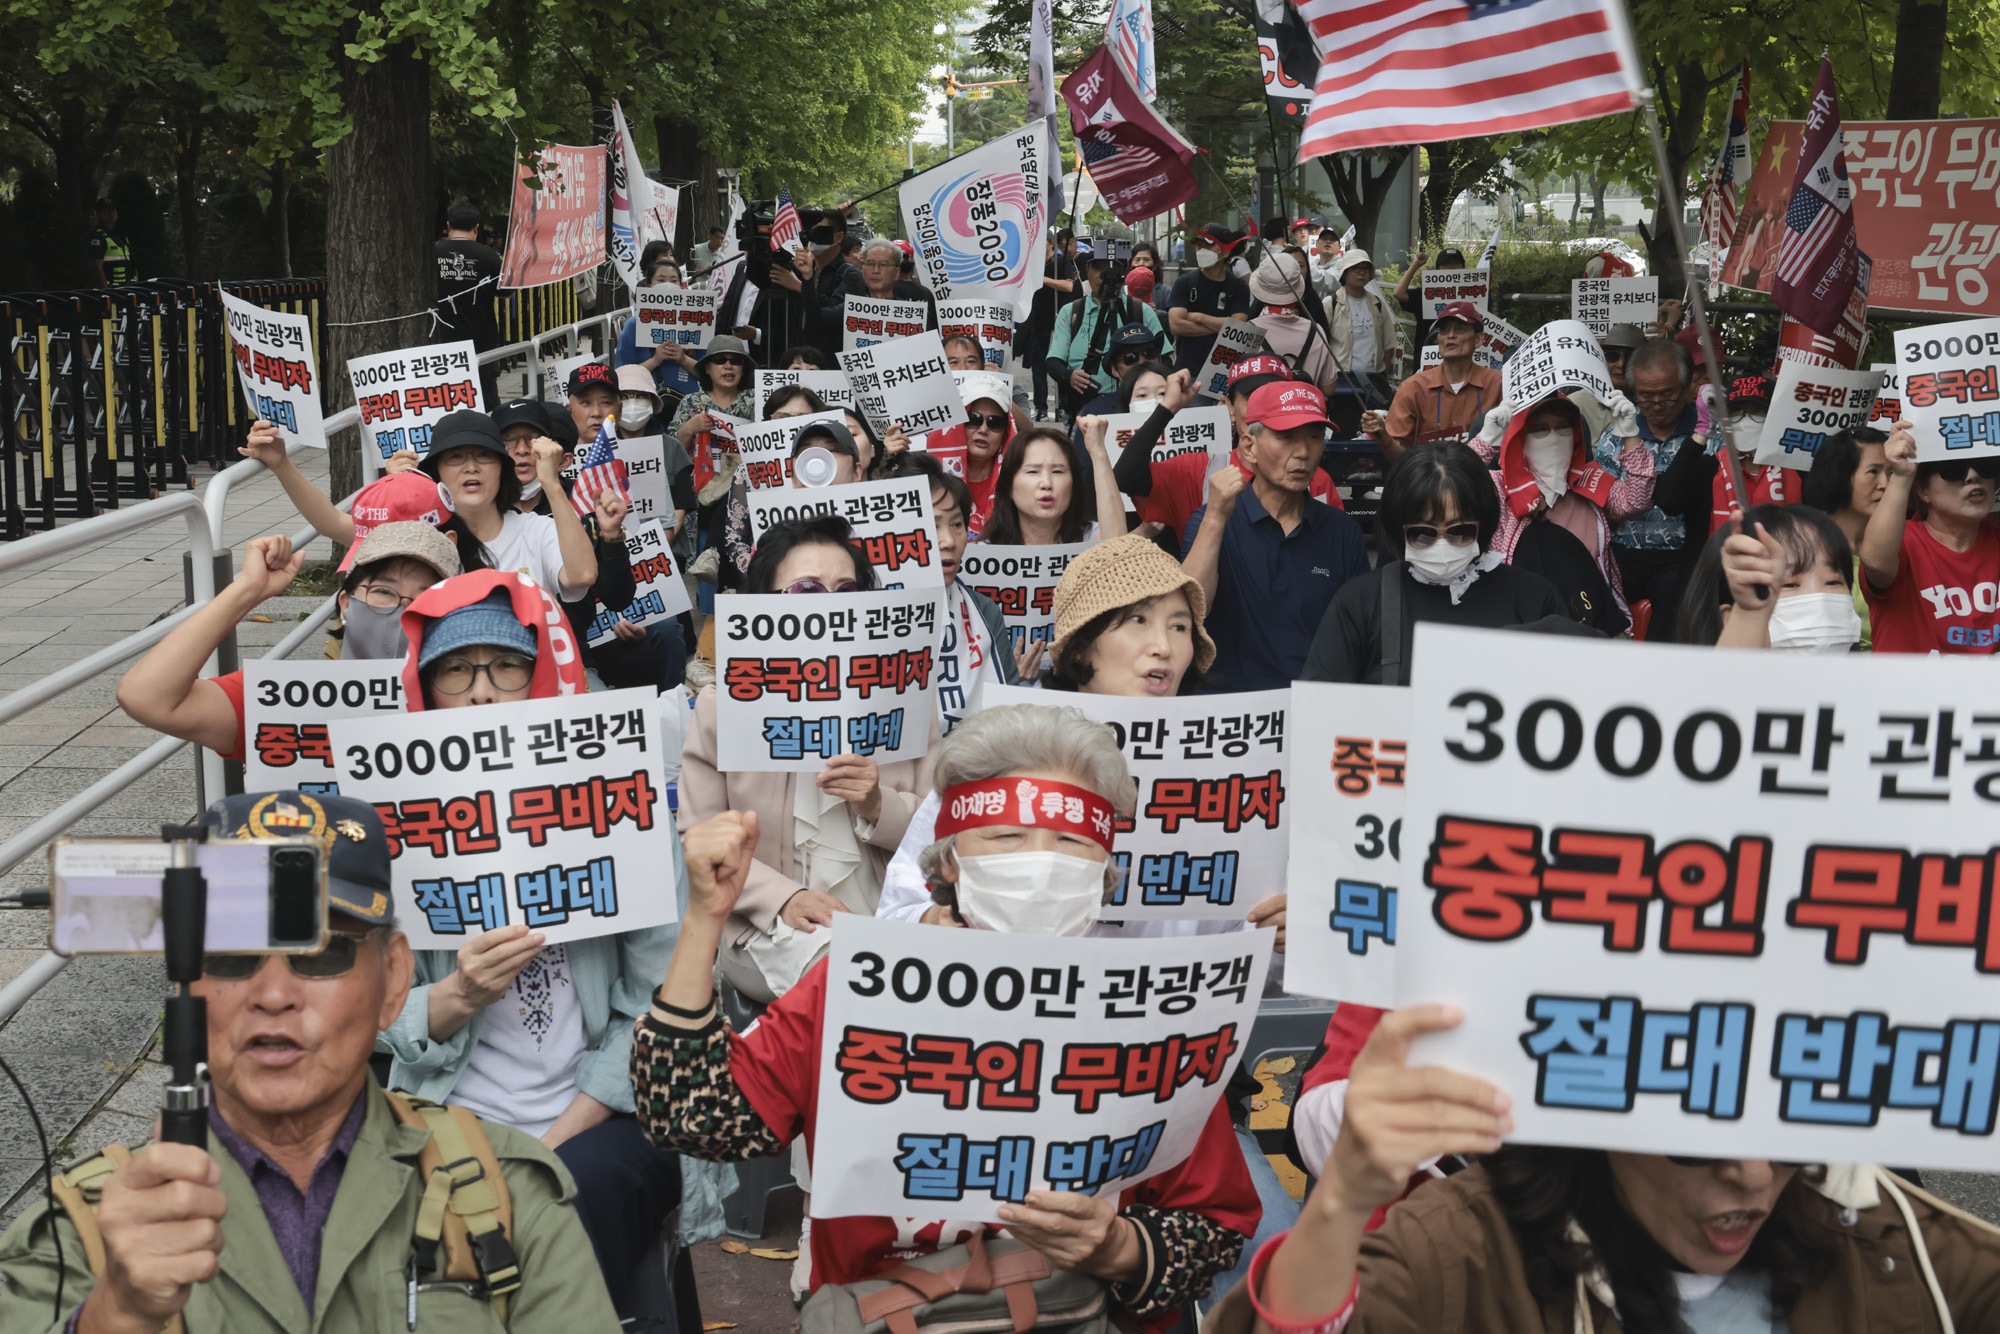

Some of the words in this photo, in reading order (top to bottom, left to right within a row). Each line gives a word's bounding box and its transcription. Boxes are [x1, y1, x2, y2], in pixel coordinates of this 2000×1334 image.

[1843, 127, 1937, 207] 중국인
[913, 202, 938, 244] 당신이
[966, 178, 1009, 283] 장풍2030
[1424, 286, 1456, 300] 중국인
[1458, 284, 1487, 298] 무비자
[1425, 274, 1461, 283] 3000만
[1463, 272, 1487, 282] 관광객
[1578, 280, 1610, 292] 중국인
[640, 294, 682, 306] 3000만
[685, 295, 714, 307] 관광객
[847, 301, 890, 317] 3000만
[893, 305, 924, 319] 관광객
[939, 305, 986, 319] 3000만
[1578, 293, 1610, 306] 관광객
[1613, 291, 1656, 305] 유치보다
[1578, 308, 1610, 320] 자국민
[639, 308, 677, 324] 중국인
[678, 310, 714, 326] 무비자
[846, 316, 883, 335] 중국인
[885, 322, 924, 337] 무비자
[255, 318, 304, 351] 관광객
[651, 328, 676, 344] 절대
[677, 330, 701, 345] 반대
[1504, 329, 1526, 345] 관광
[253, 349, 312, 395] 무비자
[352, 360, 406, 388] 3000만
[411, 350, 470, 379] 관광객
[578, 365, 610, 373] STOP
[842, 349, 876, 373] 중국인
[1210, 344, 1245, 370] 중국
[1231, 358, 1261, 378] 이재명
[1777, 345, 1827, 368] SECURITY
[578, 374, 613, 384] STEAL
[762, 372, 799, 386] 중국인
[850, 371, 882, 394] 관광객
[882, 355, 947, 389] 유치보다
[1509, 355, 1554, 393] 자국민
[1562, 368, 1614, 400] 먼저다!
[1731, 376, 1767, 387] STOP
[1906, 365, 1999, 408] 중국인
[358, 389, 402, 425] 중국인
[404, 379, 477, 416] 무비자
[859, 395, 888, 415] 자국민
[1280, 390, 1294, 405] STOP
[1295, 389, 1306, 398] THE
[1729, 388, 1768, 400] STEAL
[1794, 381, 1847, 408] 중국인
[257, 394, 298, 434] 반대
[894, 405, 953, 434] 먼저다!
[375, 427, 408, 460] 절대
[740, 429, 786, 454] 3000만
[1169, 422, 1215, 444] 관광객
[1779, 427, 1829, 457] 무비
[1939, 411, 2000, 450] 절대
[746, 458, 784, 489] 중국인
[366, 507, 389, 520] THE
[844, 490, 923, 526] 관광객
[849, 528, 932, 572] 비자
[1311, 566, 1330, 577] Jeep
[967, 586, 1028, 616] 국인
[1920, 582, 2000, 619] YOO
[727, 608, 857, 642] 3000만
[864, 601, 936, 640] 관광객
[724, 655, 841, 702] 중국인
[846, 646, 933, 699] 무비자
[257, 676, 403, 710] 3000만
[346, 725, 515, 781] 3000만
[527, 708, 648, 766] 관광객
[762, 716, 841, 760] 절대
[848, 707, 904, 757] 반대
[1179, 710, 1285, 759] 관광객
[1442, 688, 1845, 799] 3000만
[375, 789, 501, 860] 중국인
[507, 768, 659, 847] 무비자
[950, 788, 1007, 821] 이재명
[1040, 791, 1084, 824] 투쟁
[1091, 806, 1113, 840] 구속
[1145, 769, 1286, 834] 무비자
[1138, 850, 1240, 906] 반대
[1424, 812, 1773, 958] 중국인
[411, 871, 510, 936] 절대
[515, 855, 619, 928] 반대
[848, 951, 1085, 1019] 3000만
[1099, 954, 1254, 1019] 관광객
[835, 1024, 1044, 1113] 중국인
[1052, 1022, 1238, 1114] 무비자
[1518, 992, 1755, 1121] 절대
[1769, 1008, 2000, 1136] 반대
[893, 1132, 1035, 1202] 절대
[1043, 1119, 1168, 1196] 반대
